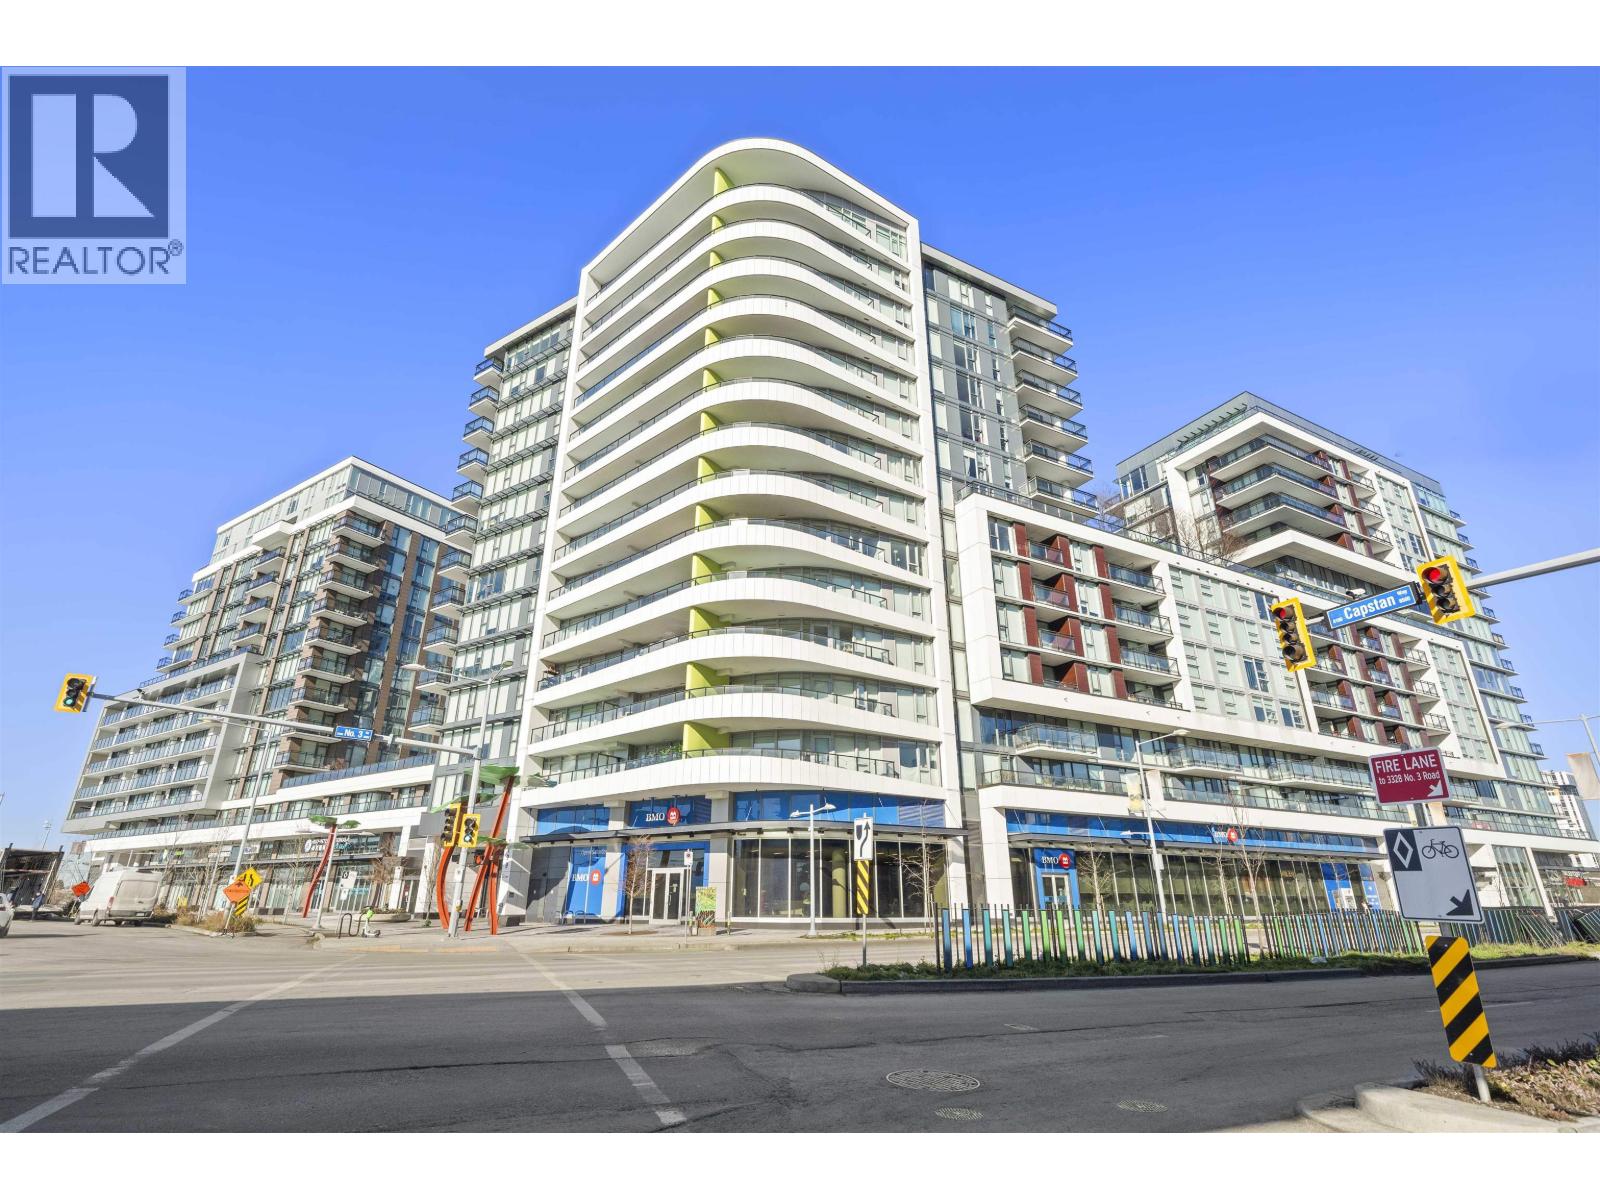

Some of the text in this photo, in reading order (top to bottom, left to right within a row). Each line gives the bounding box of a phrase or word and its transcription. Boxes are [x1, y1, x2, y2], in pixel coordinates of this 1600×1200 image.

[1343, 595, 1396, 618] Capstan
[358, 730, 363, 738] 3
[1375, 754, 1438, 774] FIRE LANE
[1378, 769, 1441, 785] to 3328 No. 3 Road
[645, 812, 665, 822] BMO
[1041, 856, 1059, 864] BMO
[571, 873, 590, 882] BMO
